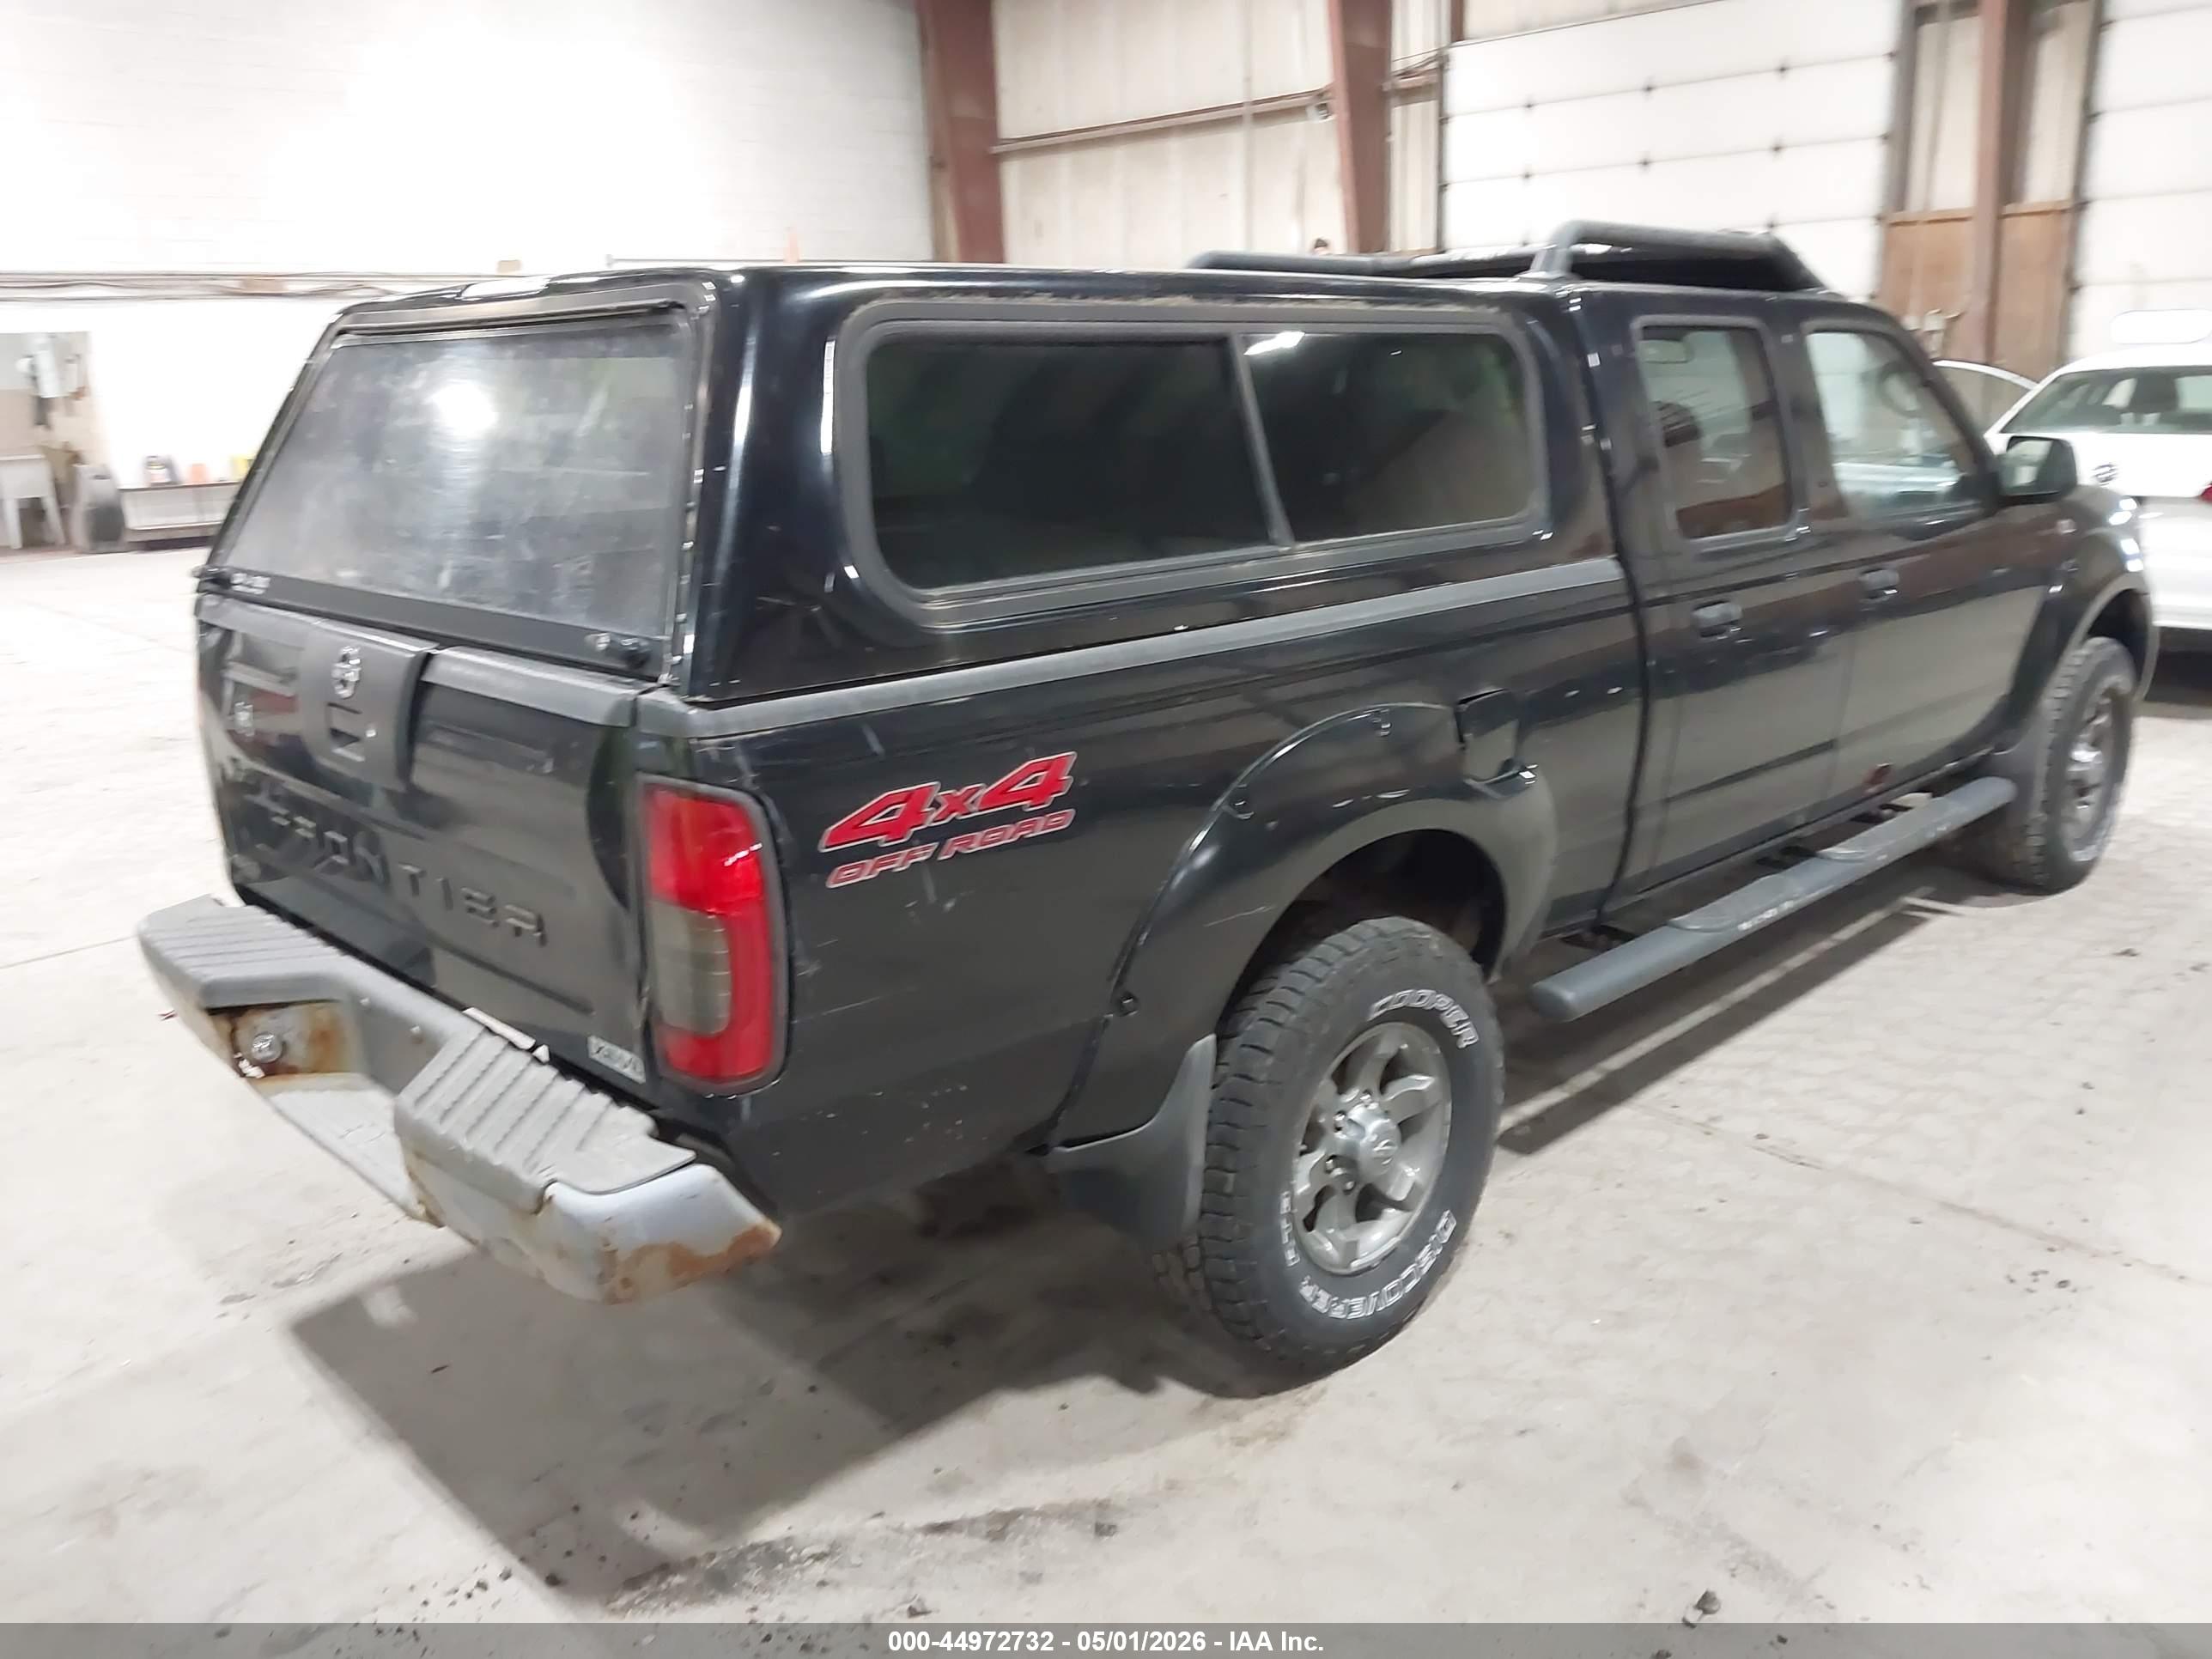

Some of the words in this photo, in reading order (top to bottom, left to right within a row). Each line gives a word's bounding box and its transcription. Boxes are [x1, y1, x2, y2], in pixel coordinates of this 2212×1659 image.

[818, 750, 1078, 853] 4x4
[825, 842, 939, 889] OFF
[937, 808, 1076, 860] ROAD
[1366, 988, 1480, 1048] COOPER
